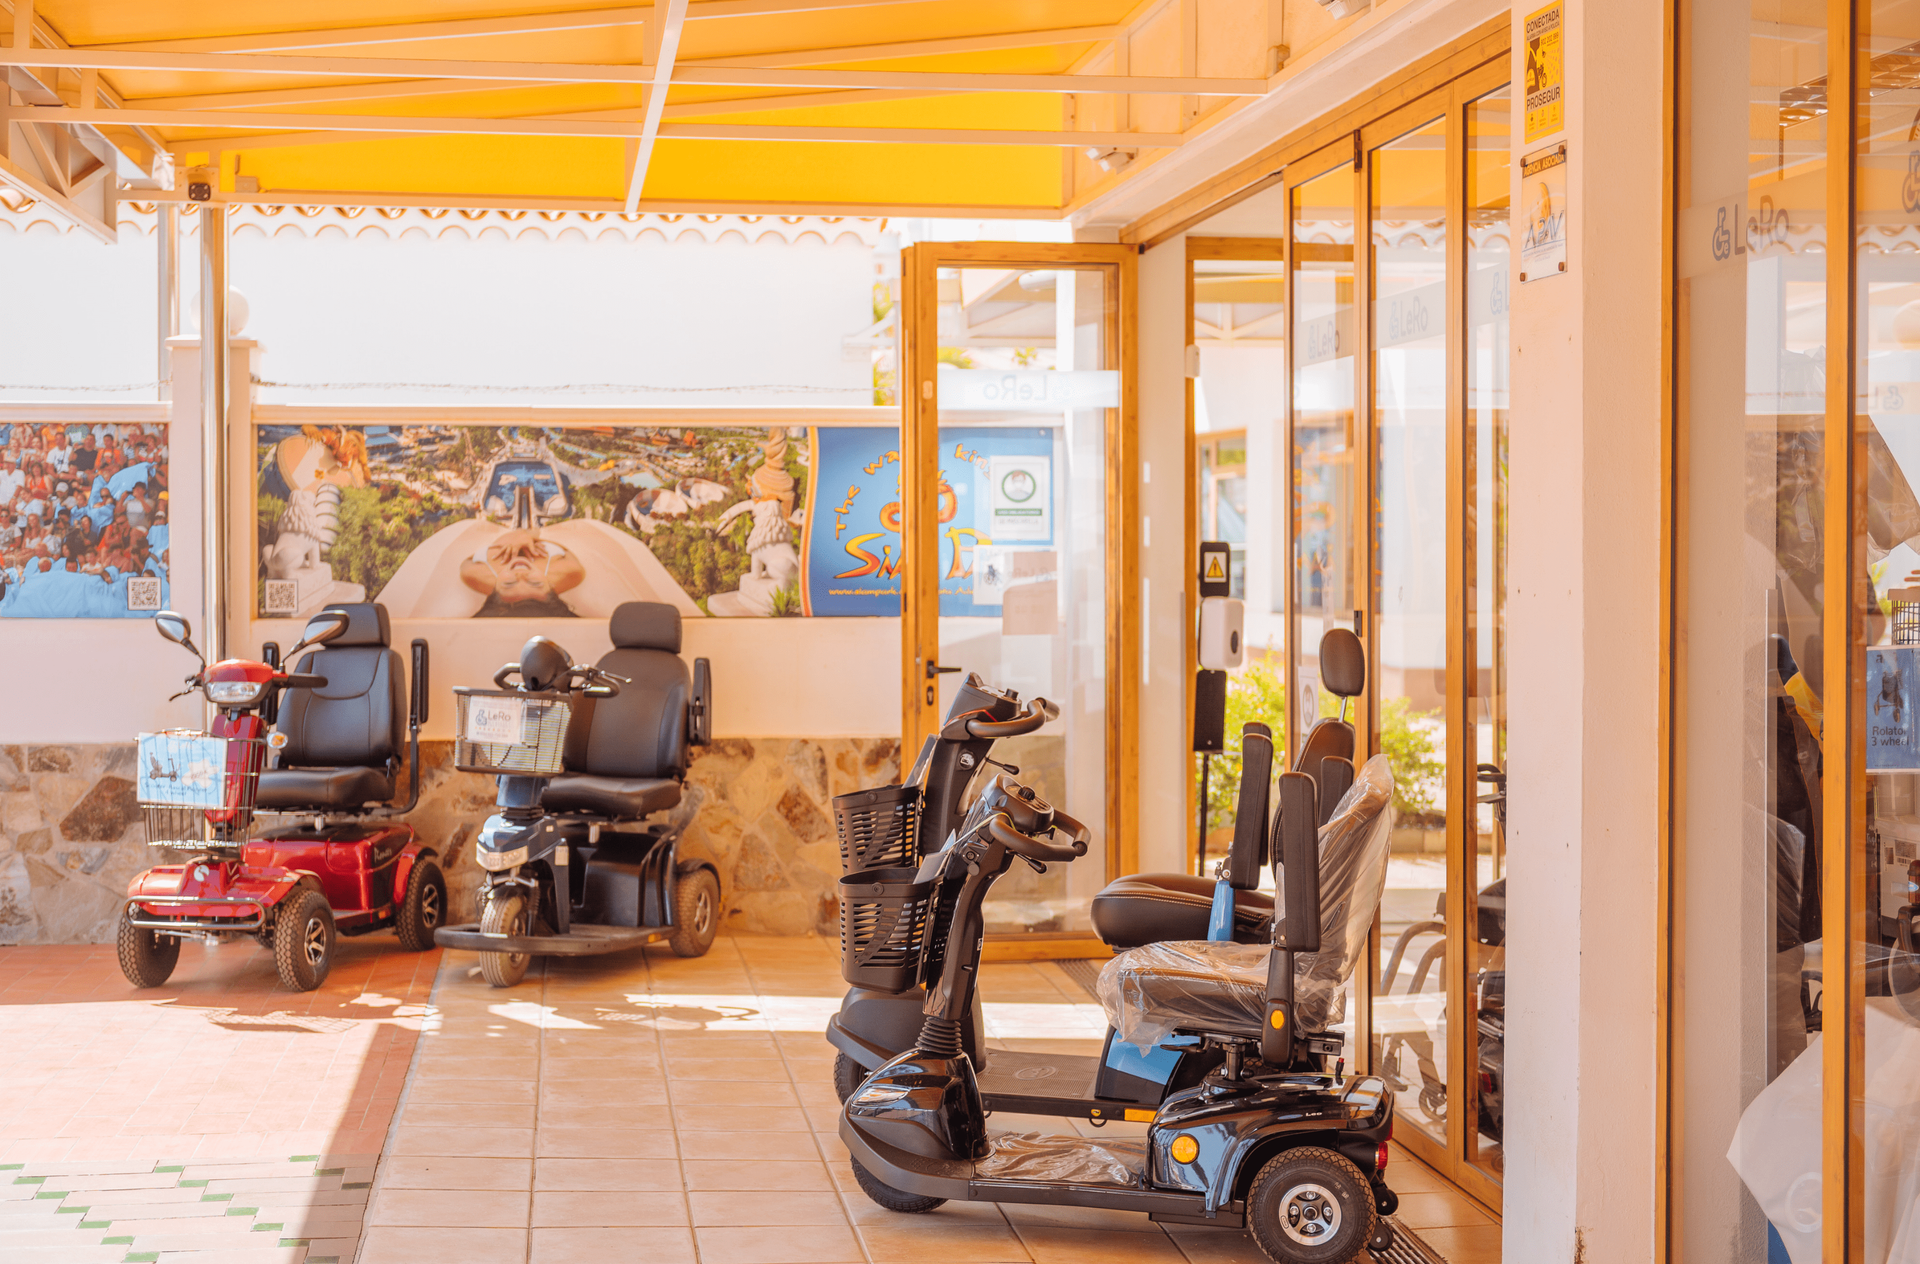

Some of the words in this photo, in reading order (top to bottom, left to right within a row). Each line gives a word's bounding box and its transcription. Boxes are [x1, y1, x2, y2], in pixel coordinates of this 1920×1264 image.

[1526, 8, 1560, 34] CONECTADA
[1526, 86, 1561, 111] PROSEGUR
[1735, 195, 1789, 255] LeRo
[1400, 295, 1429, 337] LeRo
[1316, 320, 1341, 358] LeRo
[834, 484, 861, 540] The
[488, 710, 511, 721] LeRo
[1871, 737, 1878, 746] 3
